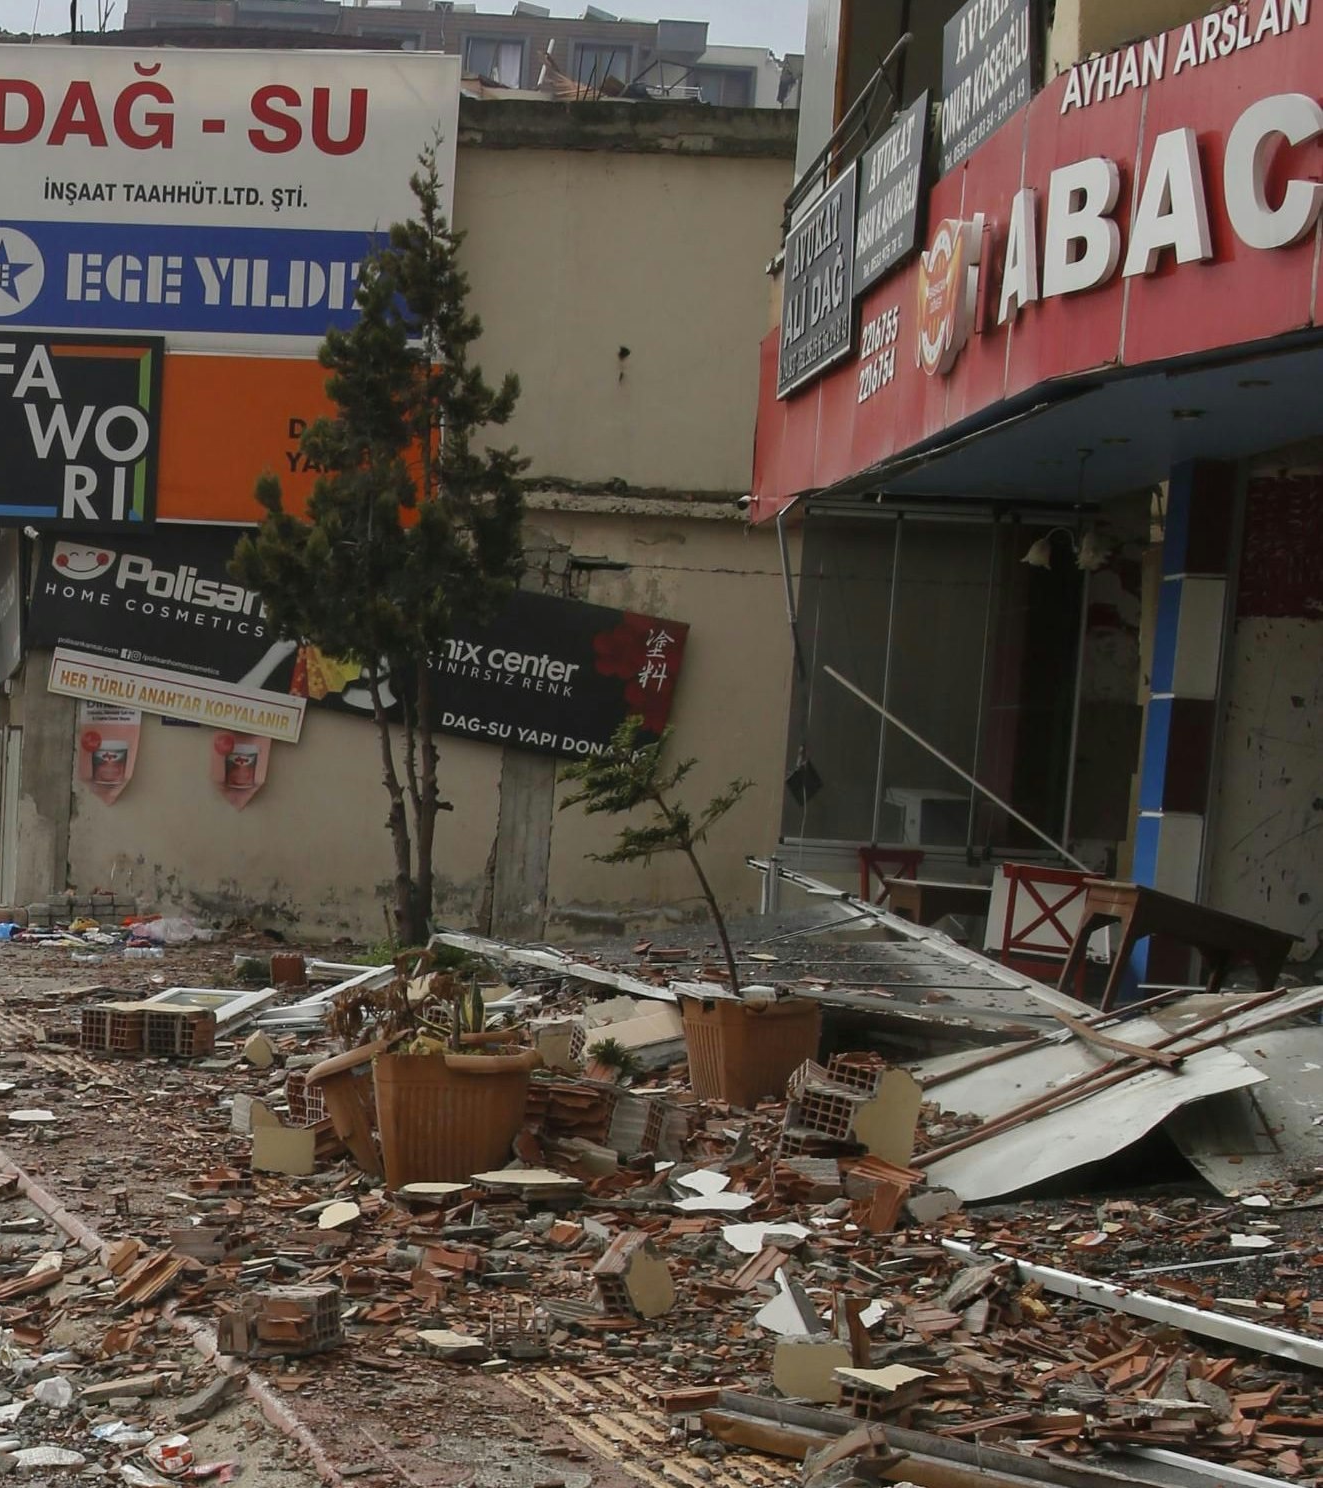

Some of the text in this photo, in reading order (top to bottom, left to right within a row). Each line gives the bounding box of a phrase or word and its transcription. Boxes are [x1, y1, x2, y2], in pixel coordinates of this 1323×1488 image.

[1061, 0, 1311, 115] AYHAN ARSLAN
[248, 84, 368, 156] SU
[942, 76, 972, 146] ONUR
[868, 113, 915, 195] AVUKAT
[44, 177, 117, 206] İNŞAAT
[271, 185, 308, 212] ŞTİ.
[998, 93, 1323, 326] ABAC
[791, 193, 842, 281] AVUKAT
[66, 253, 183, 305] EGE
[784, 276, 808, 350] ALİ
[810, 243, 846, 327] DAĞ
[860, 305, 900, 361] 2216755
[858, 347, 896, 404] 2216754
[23, 403, 149, 462] WO
[62, 464, 127, 520] RI
[45, 582, 111, 606] HOME
[125, 599, 265, 637] COSMETICS
[115, 553, 268, 619] Polisan
[426, 658, 574, 698] SINIRSIZ RENK
[487, 648, 580, 683] center
[60, 669, 289, 730] HER TÜRLÜ ANAHTAR KOPYALANIR
[442, 712, 512, 738] DAG-SU
[517, 727, 557, 748] YAPI
